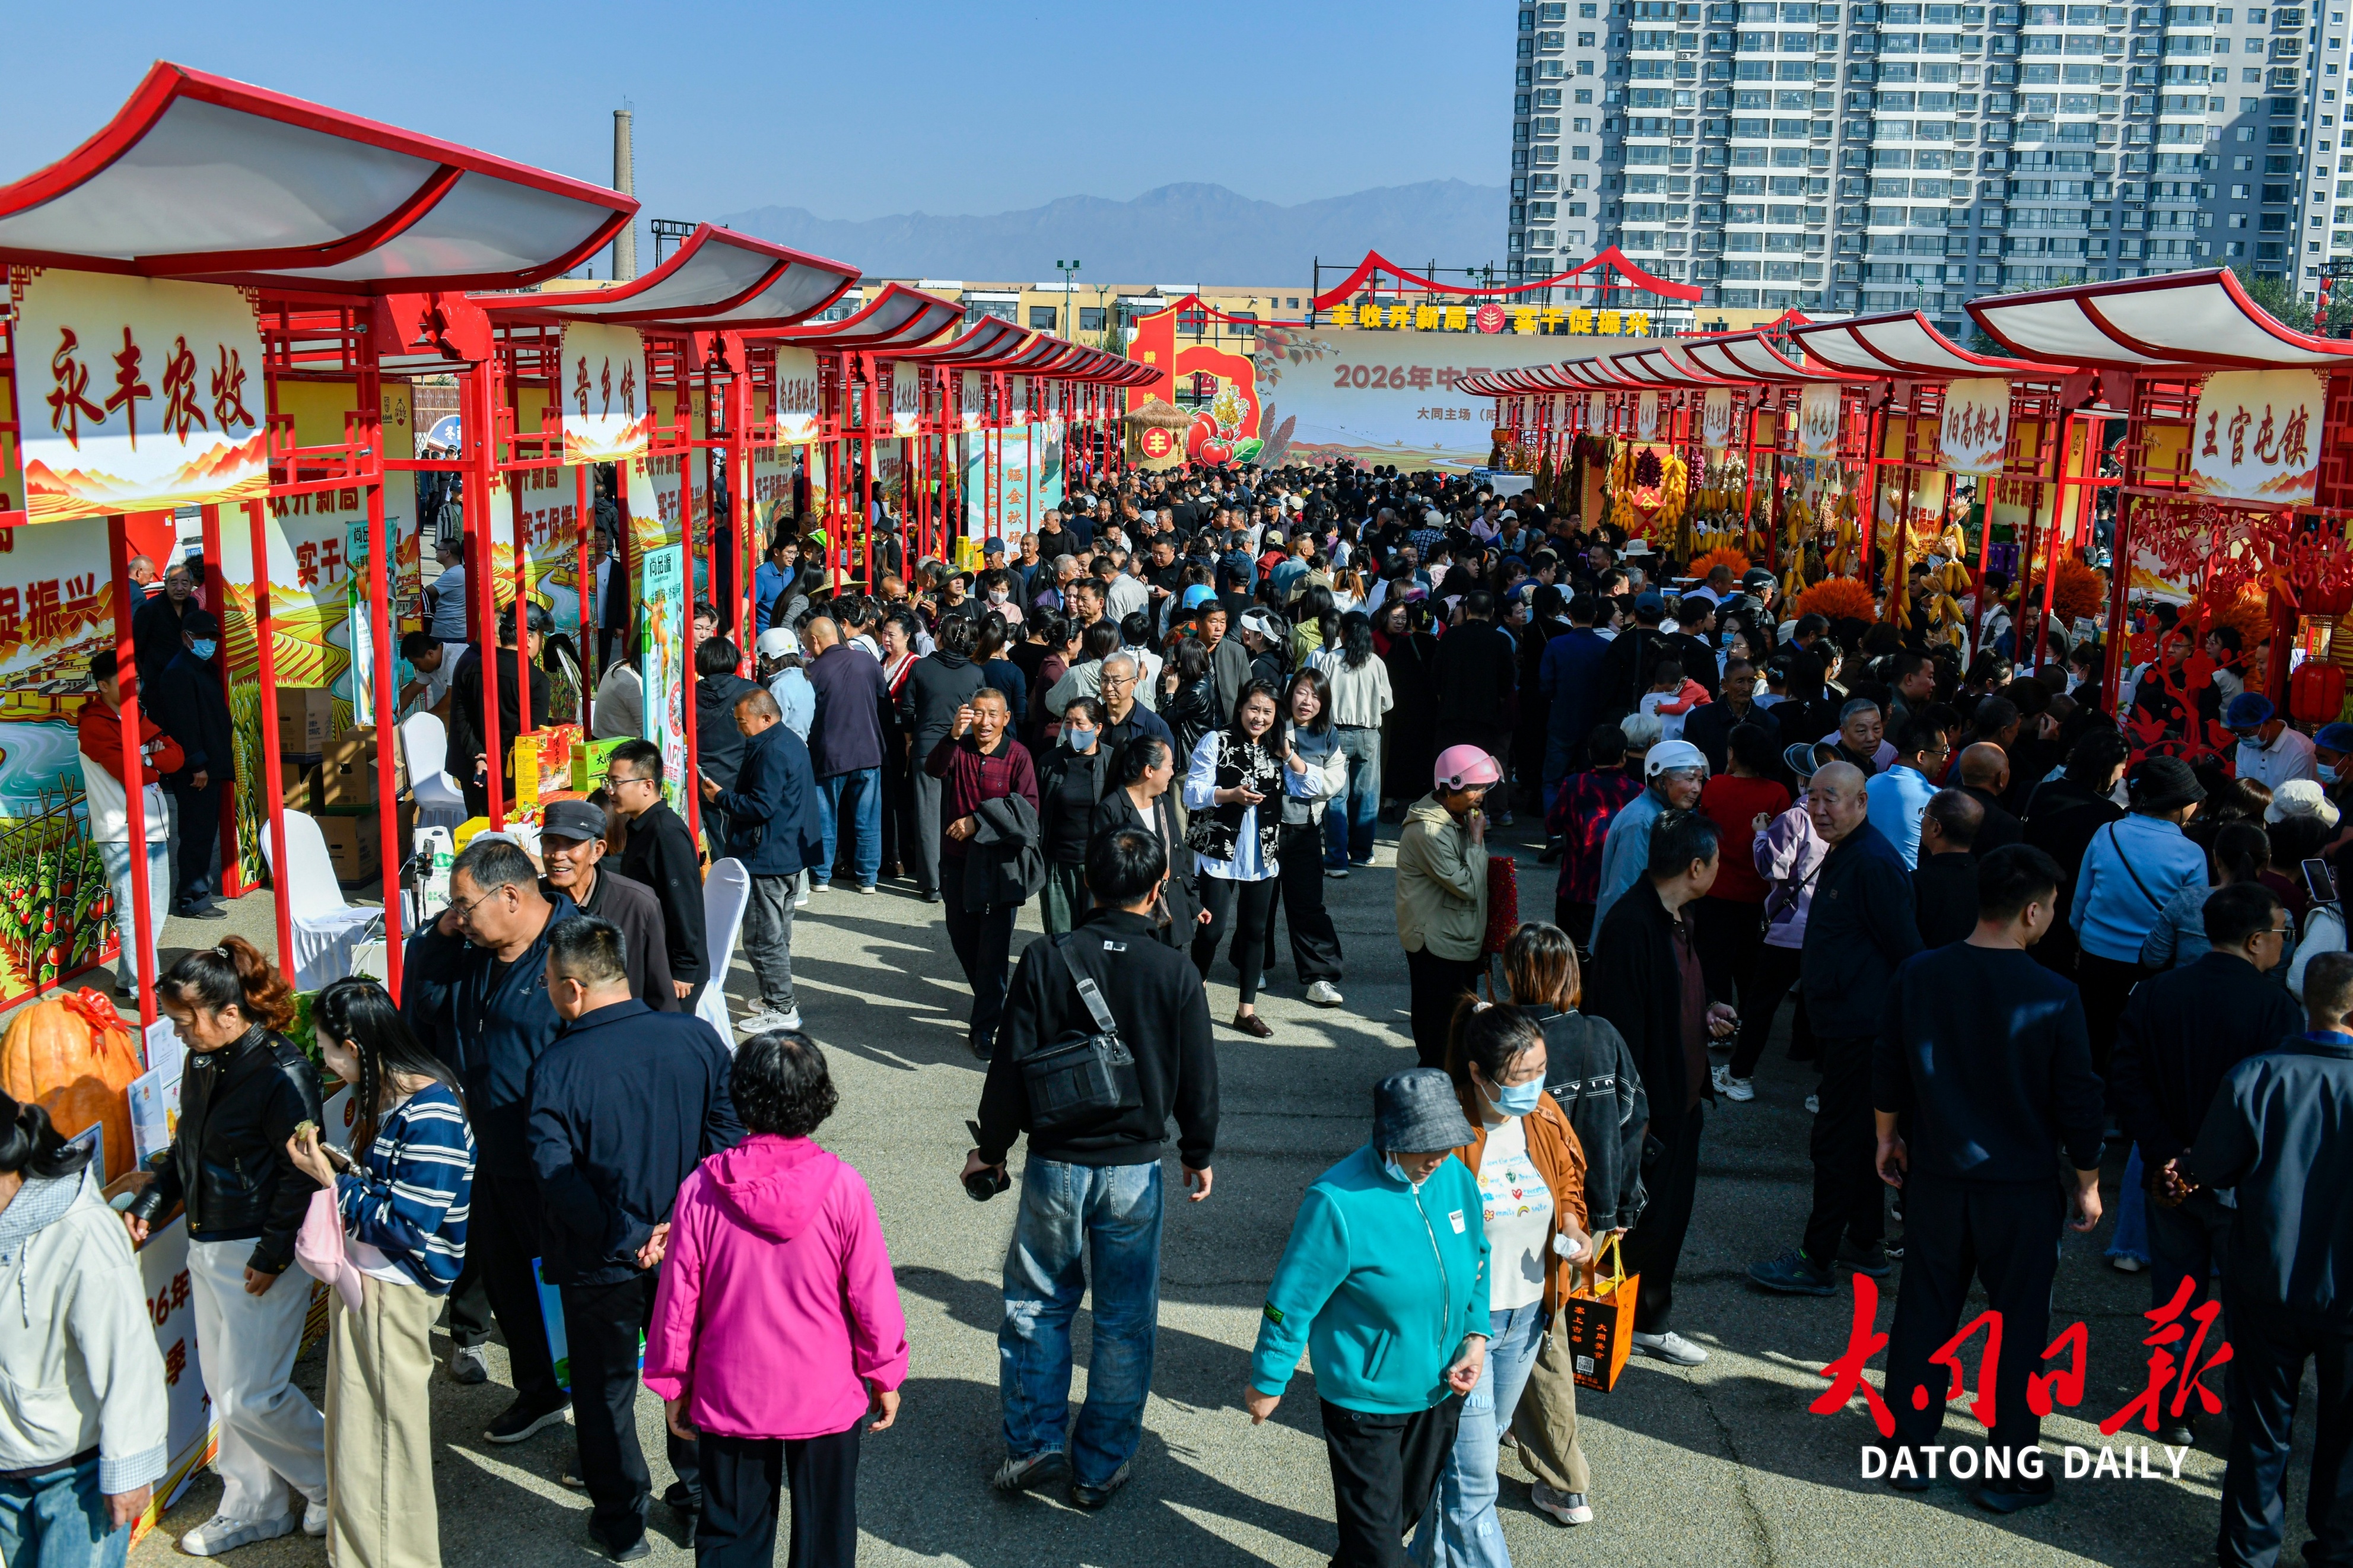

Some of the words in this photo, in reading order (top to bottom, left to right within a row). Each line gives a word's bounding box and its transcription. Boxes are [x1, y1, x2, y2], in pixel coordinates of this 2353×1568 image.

[1330, 304, 1468, 330] 丰收开新局
[1513, 308, 1650, 336] 实干促振兴
[1143, 351, 1156, 364] 耕
[46, 325, 257, 452] 永丰农牧
[573, 355, 637, 424] 晋乡情
[780, 375, 816, 416] 尚品源饮品
[1802, 400, 1837, 440] 狮子屯乡
[2202, 403, 2310, 469] 王官屯镇
[1148, 432, 1167, 453] 丰
[1637, 492, 1659, 511] 谷
[522, 502, 578, 547] 实干促振
[650, 554, 672, 577] 尚品源
[1571, 1306, 1585, 1343] 塞上古都
[1593, 1323, 1607, 1360] 大同美食
